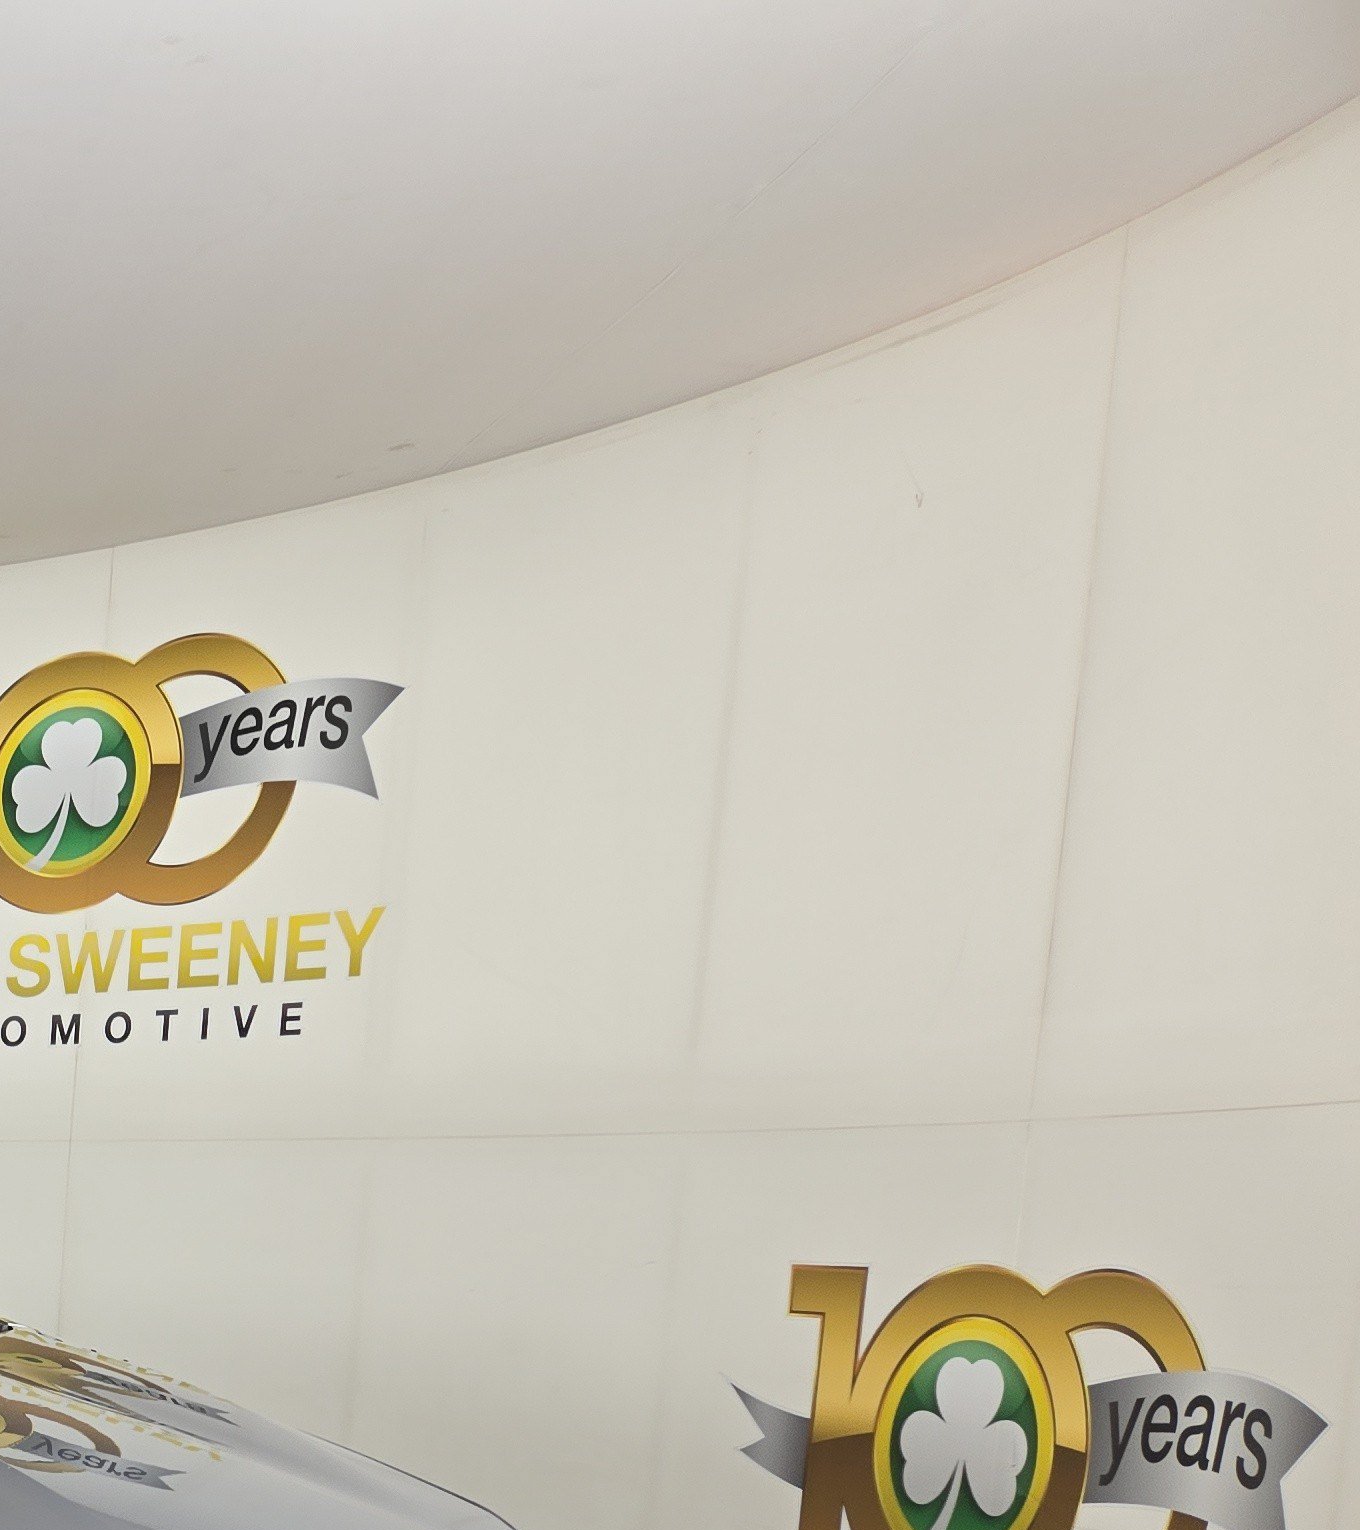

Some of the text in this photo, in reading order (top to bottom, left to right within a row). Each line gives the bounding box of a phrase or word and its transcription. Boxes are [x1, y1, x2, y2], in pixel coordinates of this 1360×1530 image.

[193, 695, 354, 784] years
[5, 906, 387, 999] SWEENEY
[1099, 1393, 1273, 1491] years
